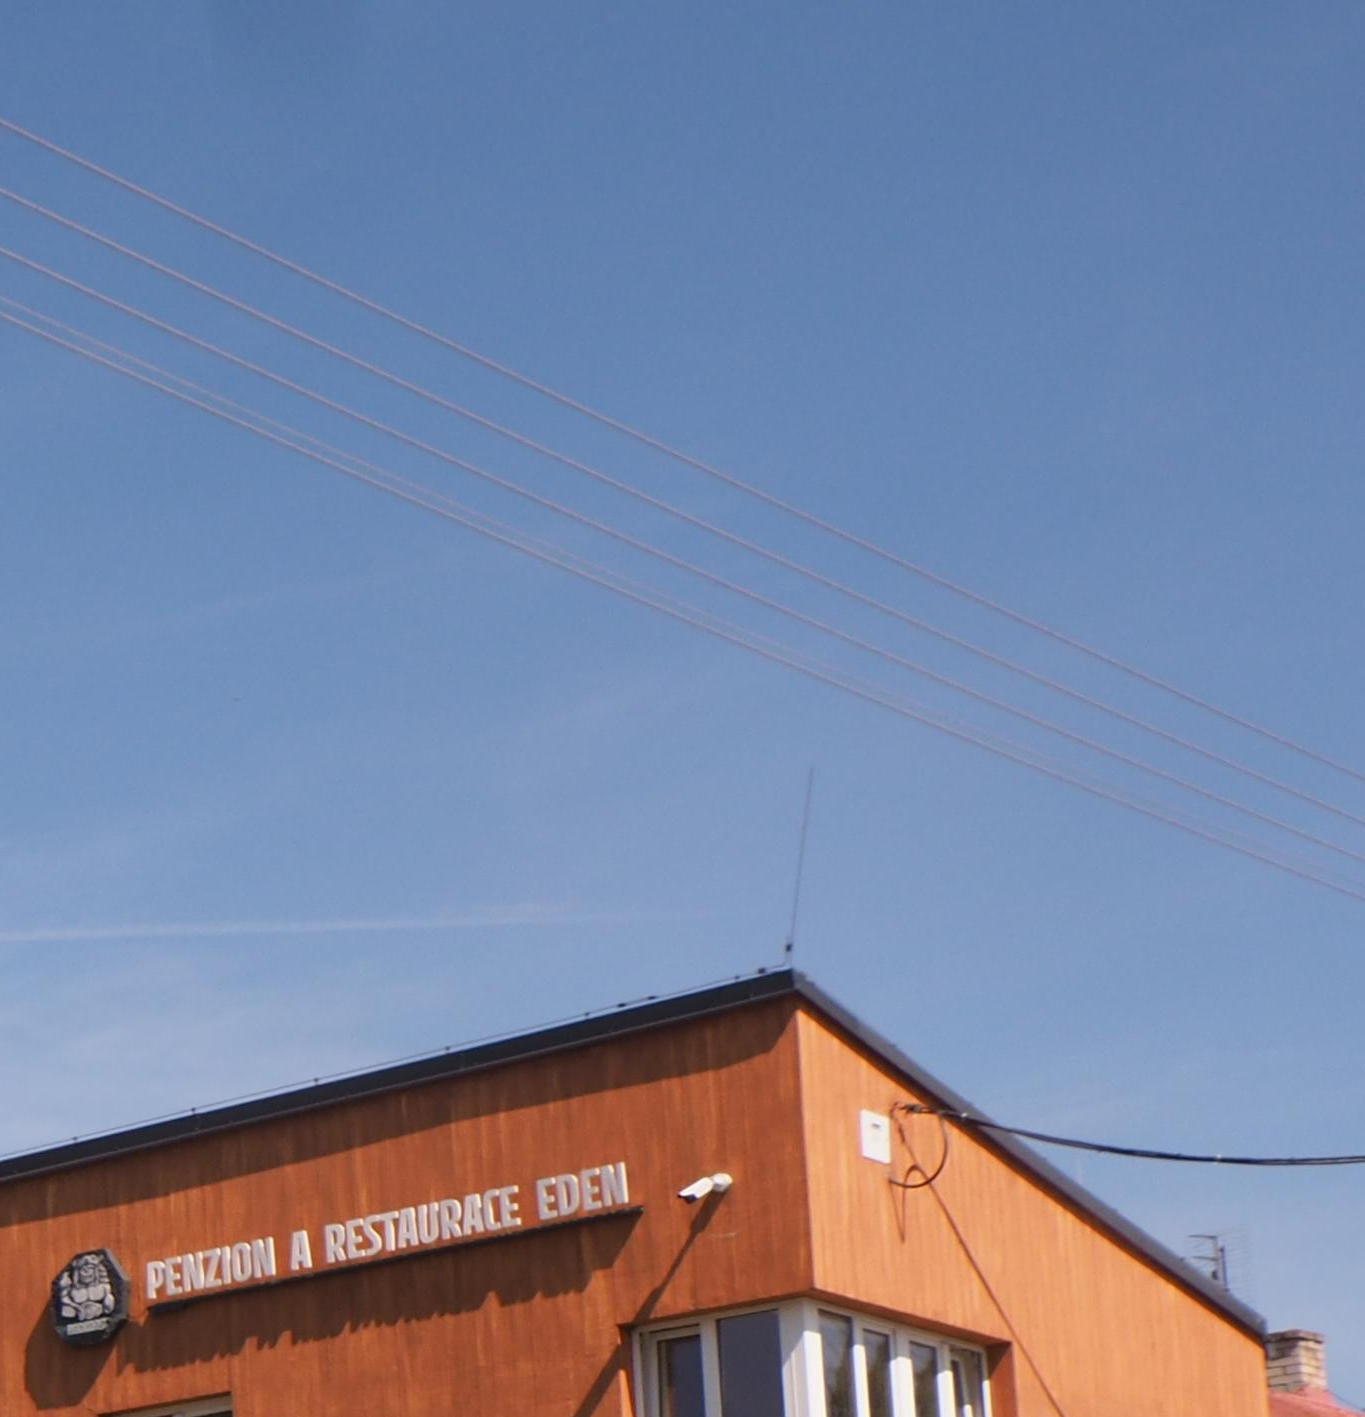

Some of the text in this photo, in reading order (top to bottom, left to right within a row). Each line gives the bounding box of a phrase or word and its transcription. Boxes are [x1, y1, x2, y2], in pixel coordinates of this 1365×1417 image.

[146, 1161, 629, 1300] PENZION A RESTAURACE EDEN
